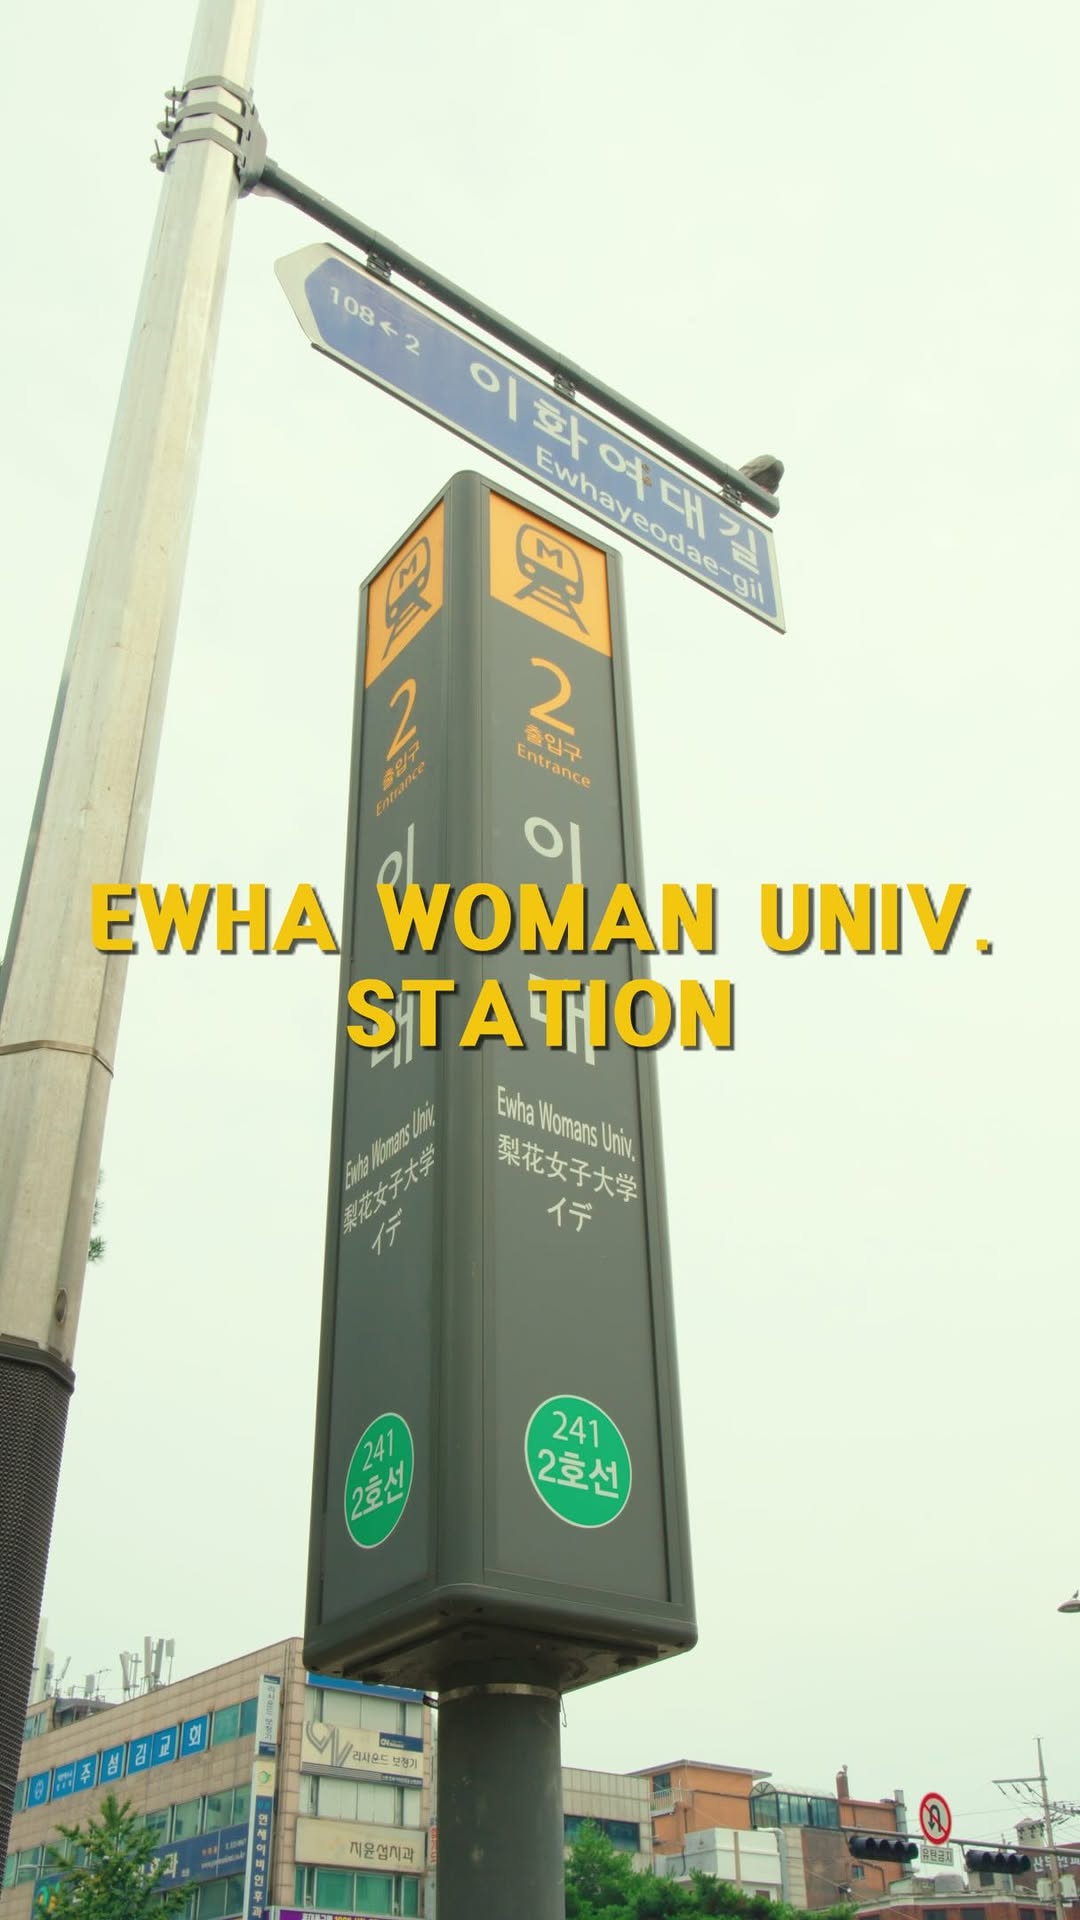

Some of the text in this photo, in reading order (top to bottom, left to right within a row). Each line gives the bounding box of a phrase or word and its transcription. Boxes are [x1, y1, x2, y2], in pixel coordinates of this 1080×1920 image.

[329, 286, 375, 328] 108
[470, 361, 761, 576] 이화여대길
[536, 446, 764, 606] Ewhayeodae-gil
[386, 677, 417, 762] 2
[529, 656, 576, 737] 2
[382, 740, 420, 791] 출입구
[516, 743, 592, 789] Entrance
[524, 723, 583, 763] 출입구
[375, 761, 425, 817] Entrance
[345, 1101, 436, 1191] Ewha Womans Univ.
[497, 1085, 637, 1162] Ewha Womans Univ.
[343, 1143, 435, 1235] 梨花女子大学
[498, 1133, 638, 1203] 梨花女子大学
[371, 1207, 403, 1256] イデ
[547, 1196, 593, 1233] イデ
[362, 1428, 394, 1472] 241
[552, 1410, 599, 1448] 241
[351, 1460, 404, 1521] 2호선
[537, 1448, 620, 1499] 2호선
[80, 1723, 202, 1785] 주섬김교회
[252, 1814, 268, 1919] 연세이비인후과
[922, 1848, 952, 1863] 유턴금지
